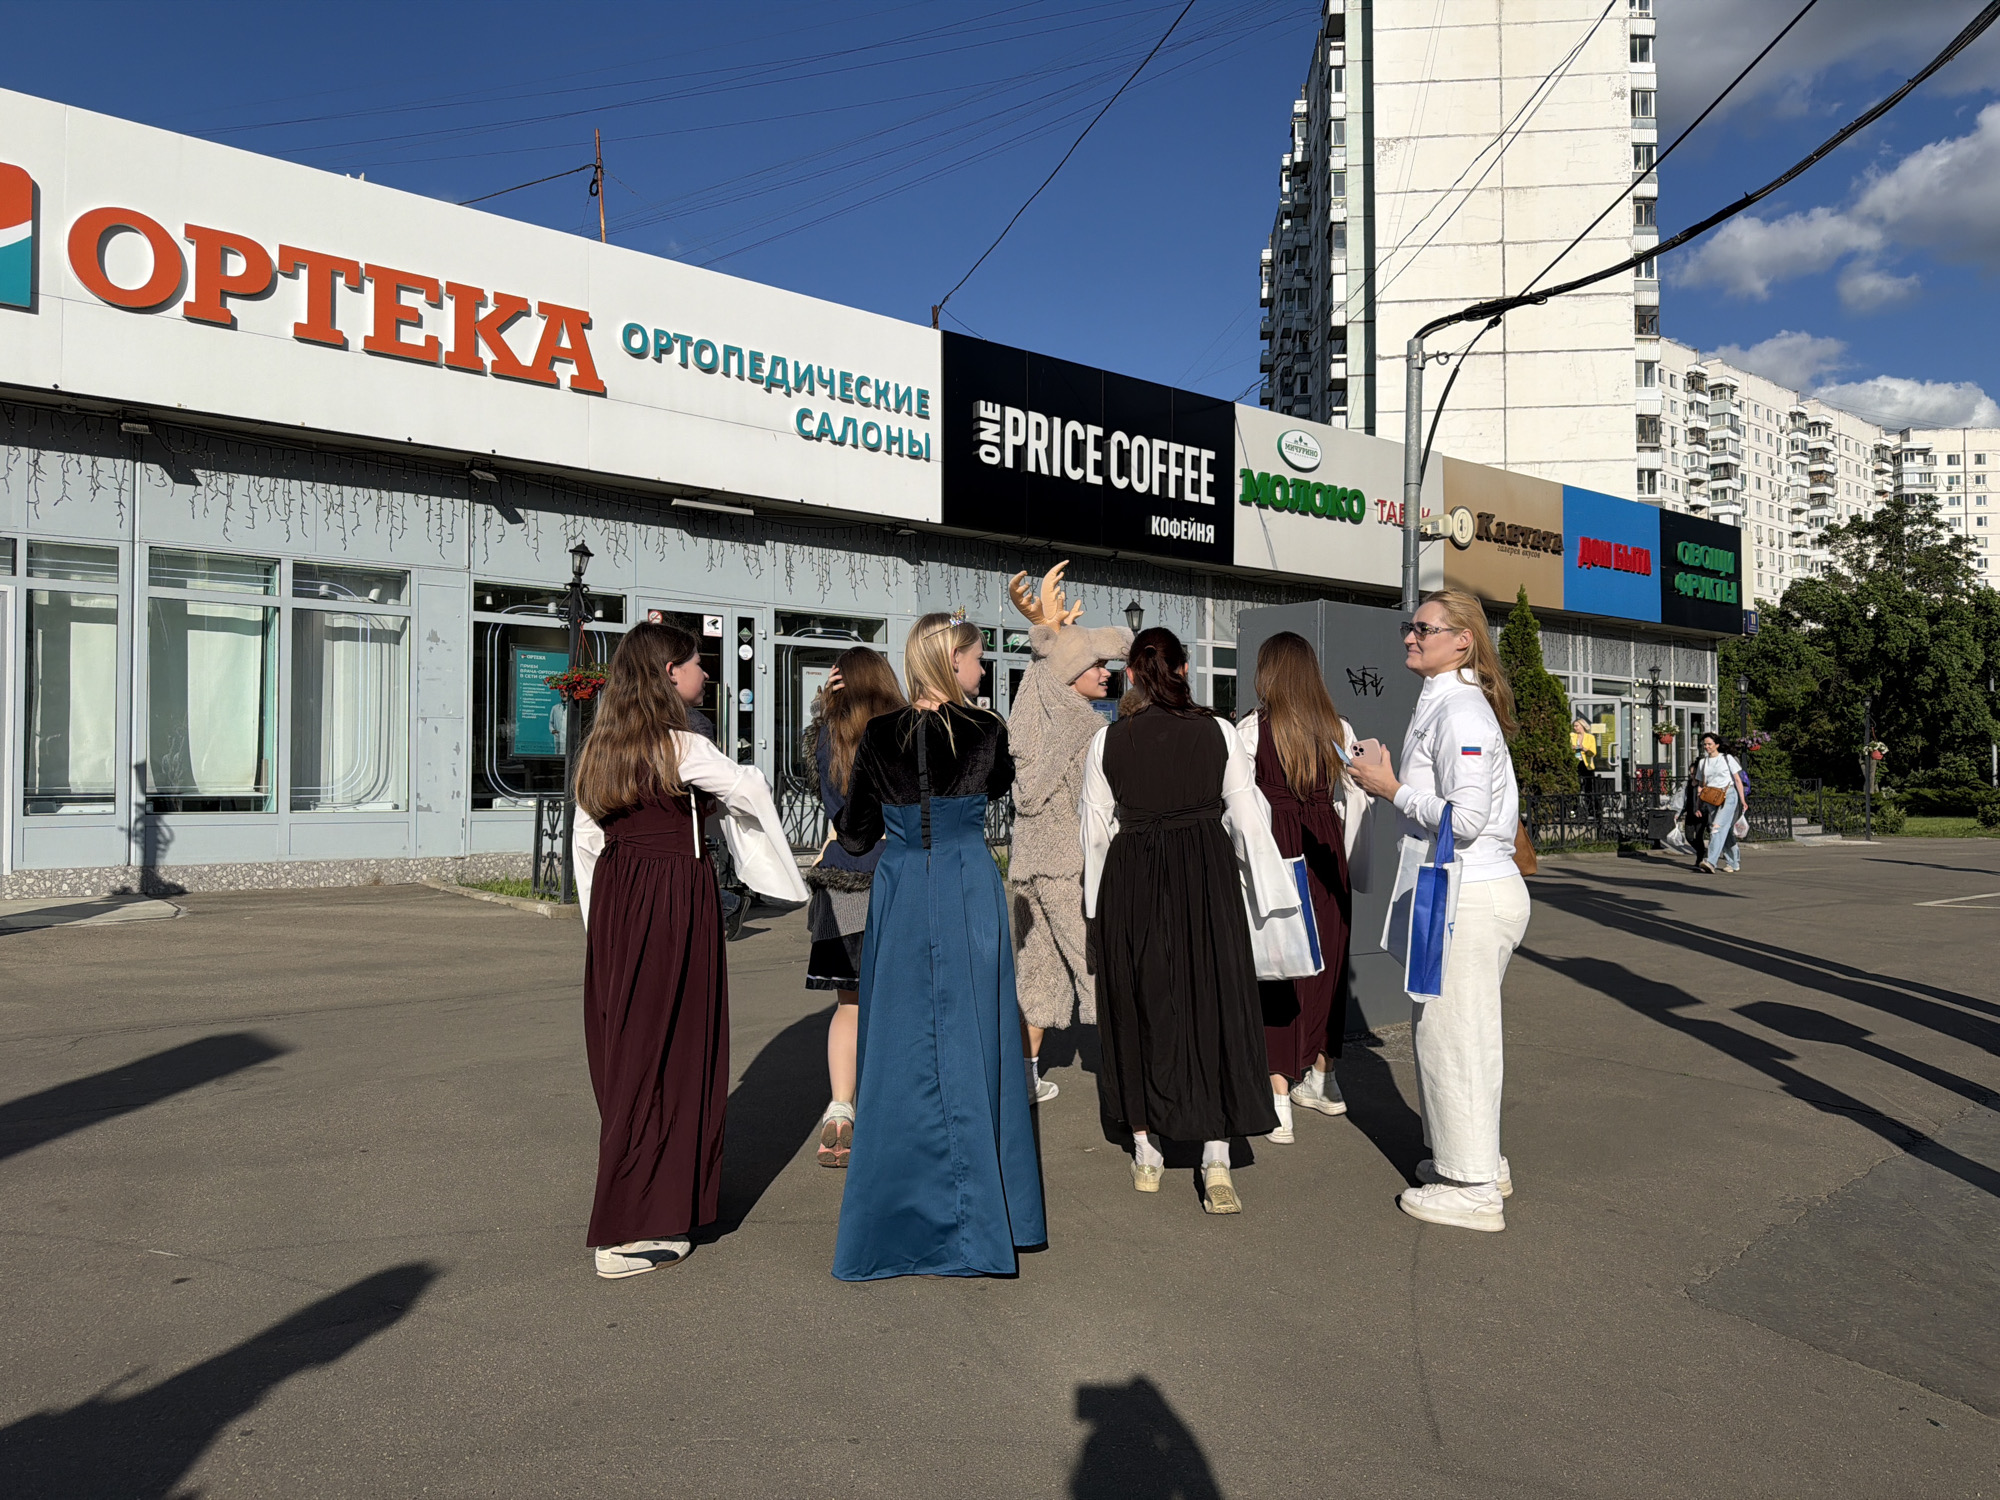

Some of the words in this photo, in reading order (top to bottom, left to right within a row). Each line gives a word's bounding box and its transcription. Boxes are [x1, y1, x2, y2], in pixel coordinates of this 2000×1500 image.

[67, 206, 605, 394] ОРТЕКА
[621, 322, 930, 417] ОРТОПЕДИЧЕСКИЕ
[795, 407, 931, 460] САЛОНЫ
[977, 400, 1001, 465] ONE
[1004, 405, 1104, 486] PRICE
[1109, 429, 1216, 506] COFFEE
[1284, 442, 1318, 458] МИЧУРИНО
[1239, 468, 1366, 522] МОЛОКО
[1151, 515, 1215, 544] КОФЕЙНЯ
[1677, 540, 1735, 576] ОВОЩИ
[1675, 571, 1738, 604] ФРУКТЫ
